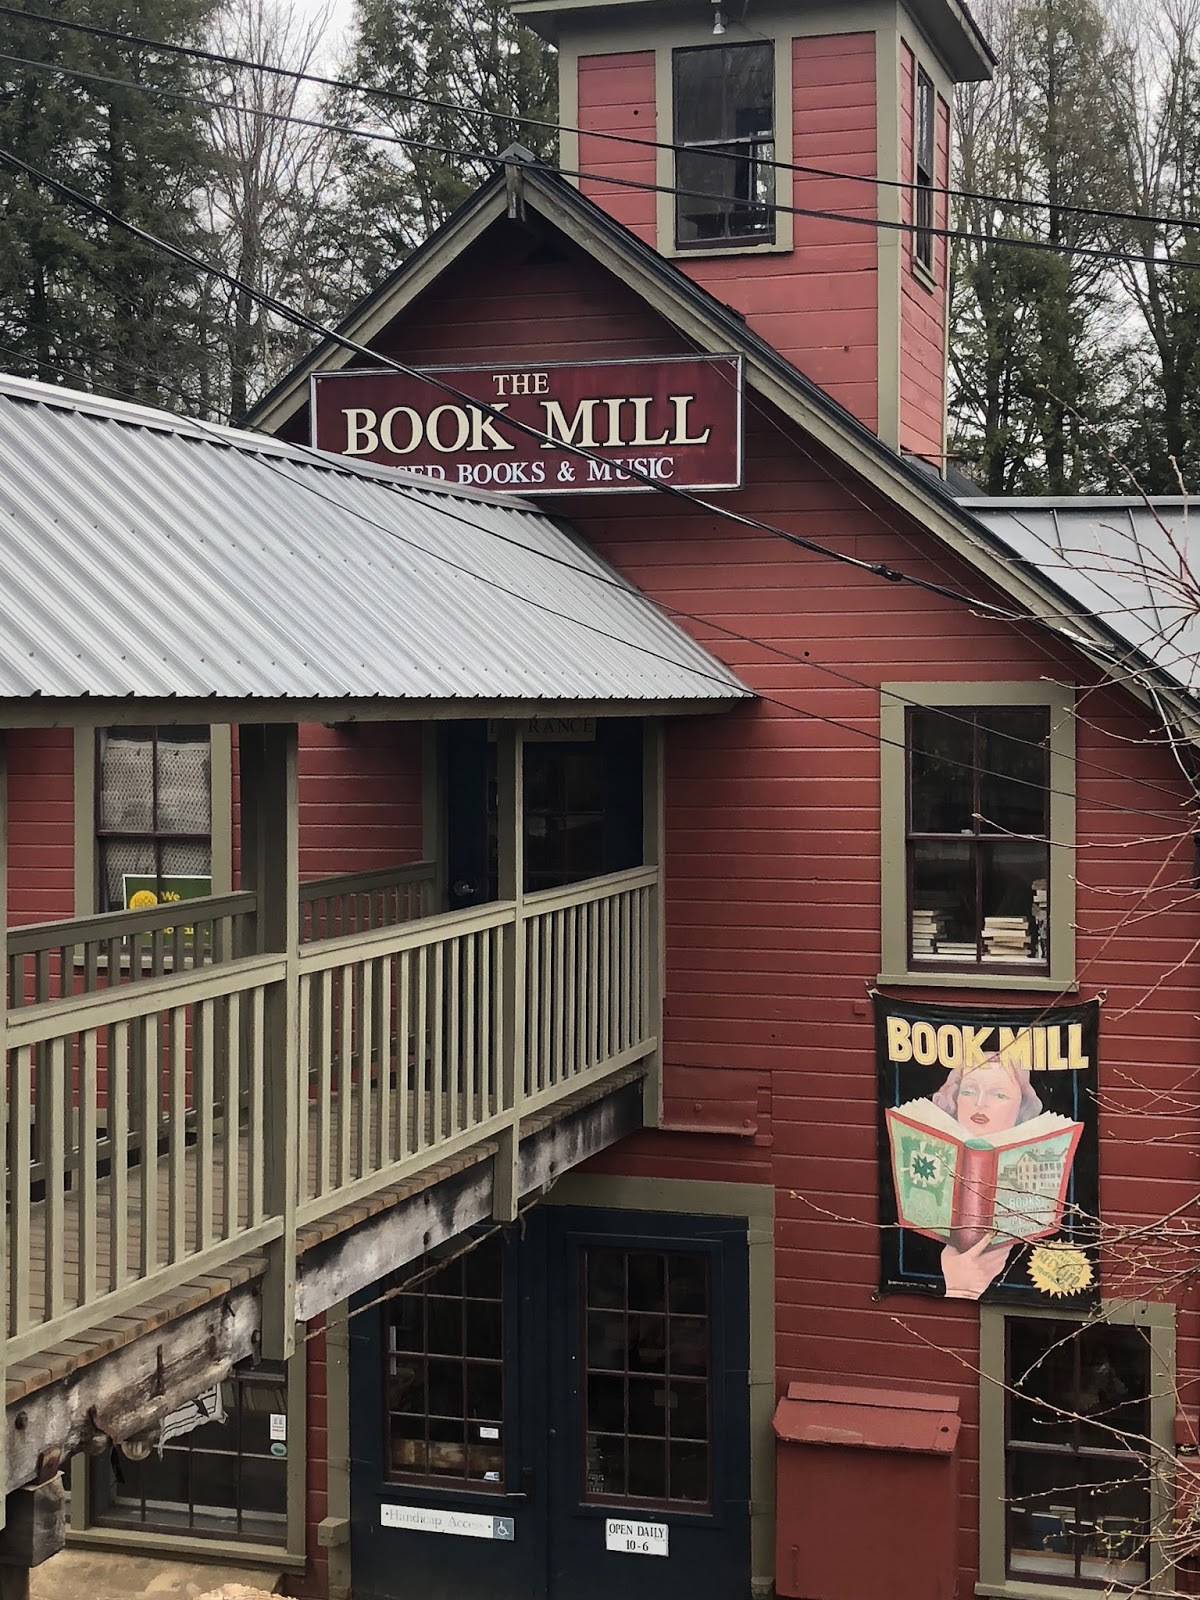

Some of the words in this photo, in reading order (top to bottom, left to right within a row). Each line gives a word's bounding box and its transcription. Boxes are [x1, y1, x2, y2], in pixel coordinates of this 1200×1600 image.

[492, 373, 550, 396] THE
[341, 402, 515, 456] BOOK
[540, 395, 711, 450] MILL
[456, 461, 546, 485] BOOKS
[557, 464, 577, 482] &
[587, 456, 675, 482] MUSIC
[161, 891, 180, 901] We
[886, 1016, 995, 1070] BOOK
[999, 1023, 1090, 1072] MILL
[1009, 1195, 1042, 1208] BOOKS
[389, 1508, 442, 1529] Handicap
[447, 1516, 484, 1529] Access
[608, 1523, 633, 1535] OPEN
[637, 1525, 665, 1538] DAILY
